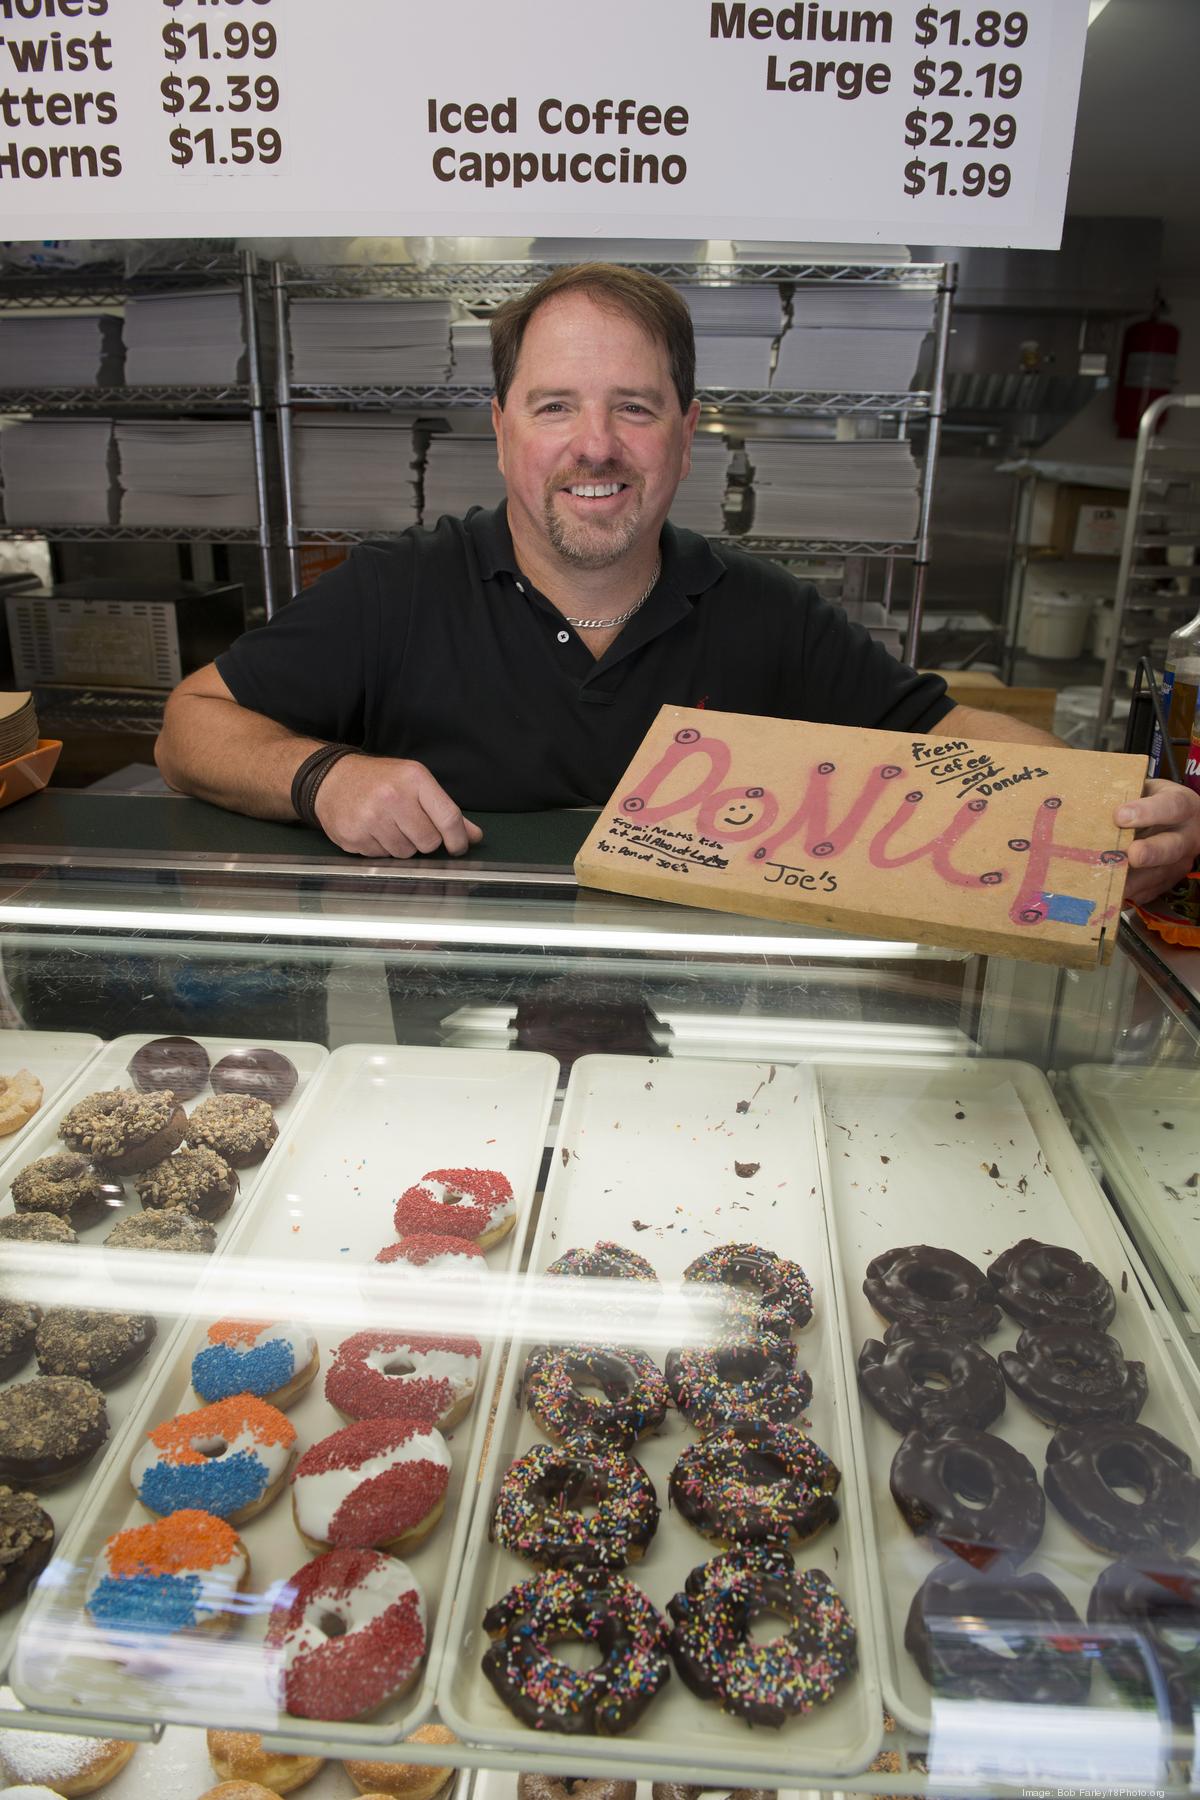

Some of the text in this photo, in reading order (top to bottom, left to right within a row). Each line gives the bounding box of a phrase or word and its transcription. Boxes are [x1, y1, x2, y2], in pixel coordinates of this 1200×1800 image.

[0, 17, 277, 72] wist $1.99
[710, 2, 1028, 49] Medium $1.89
[160, 71, 280, 117] $2.39
[766, 55, 1023, 100] Large $2.19
[427, 97, 1017, 150] Iced Coffee $2.29
[169, 124, 282, 168] $1.59
[432, 146, 1012, 199] Cappuccino $1.99
[911, 740, 969, 761] Fresh
[961, 765, 1002, 786] and
[975, 766, 1049, 796] Donuts
[631, 833, 651, 844] all
[763, 861, 838, 892] Joe's
